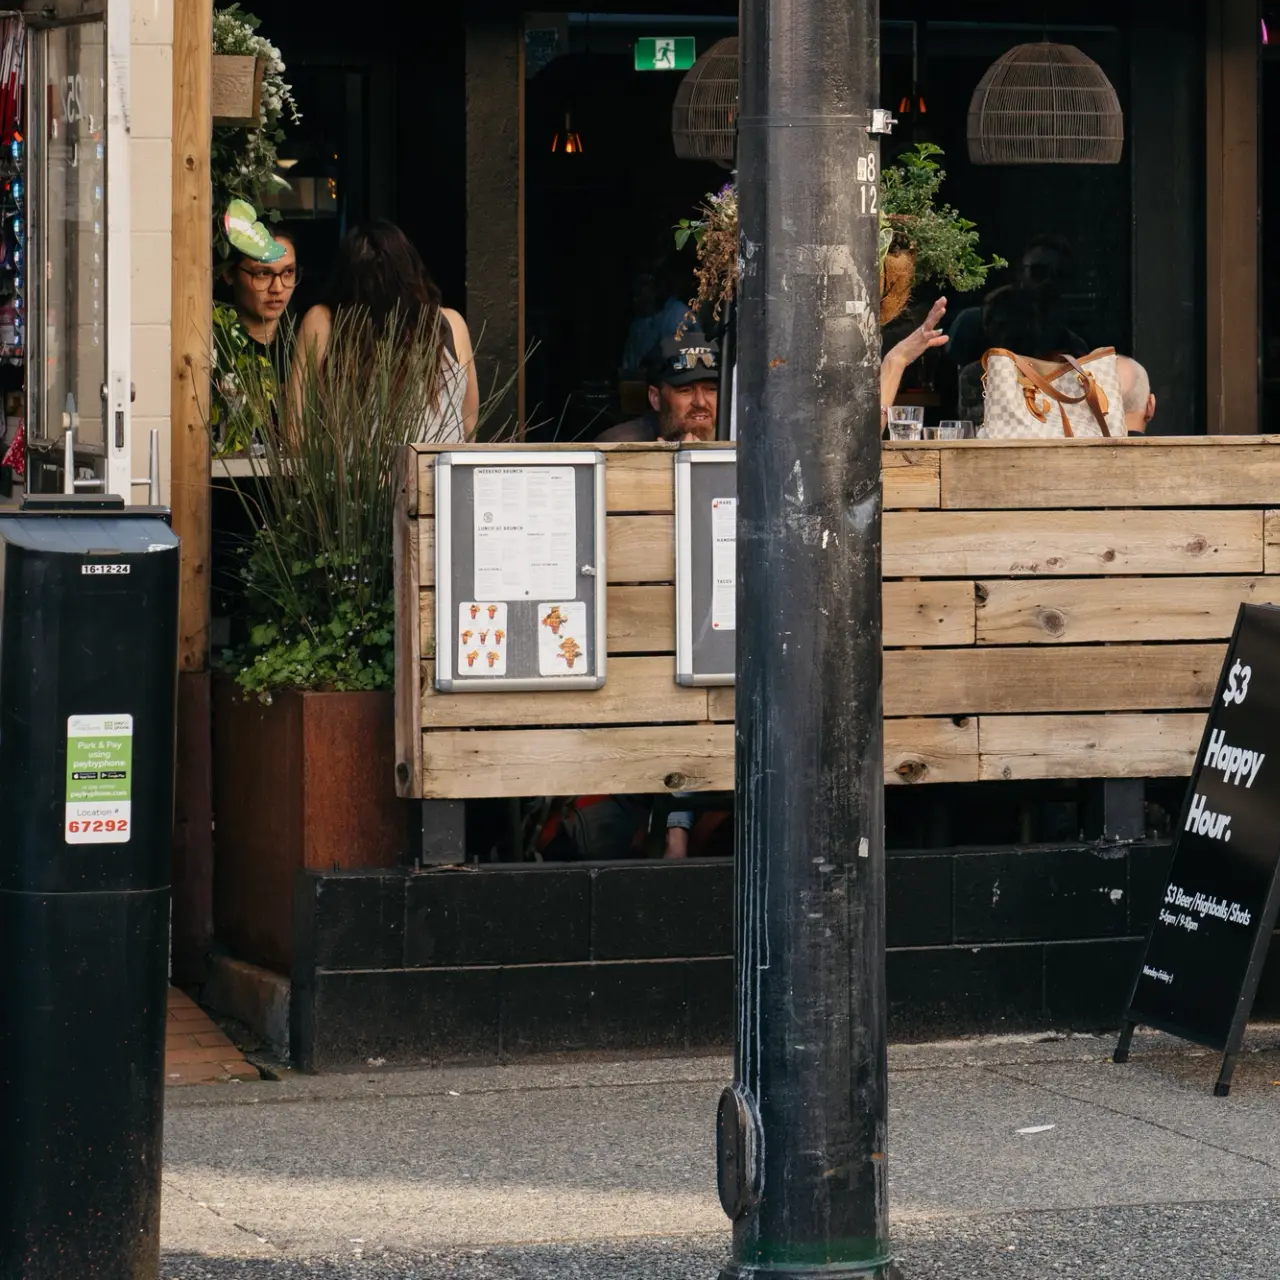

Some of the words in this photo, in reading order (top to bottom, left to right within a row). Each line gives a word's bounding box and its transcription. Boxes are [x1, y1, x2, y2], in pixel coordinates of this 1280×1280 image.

[860, 185, 877, 214] 12
[84, 565, 128, 574] 16-12-24
[1222, 658, 1252, 708] $3
[77, 741, 96, 749] Park
[106, 741, 122, 751] Pay
[88, 751, 111, 760] using
[1203, 728, 1266, 789] Happy
[73, 760, 126, 770] paybyphone
[77, 808, 112, 817] Location
[1184, 793, 1232, 843] Hour.
[68, 820, 128, 833] 67292
[1164, 882, 1178, 905] $3
